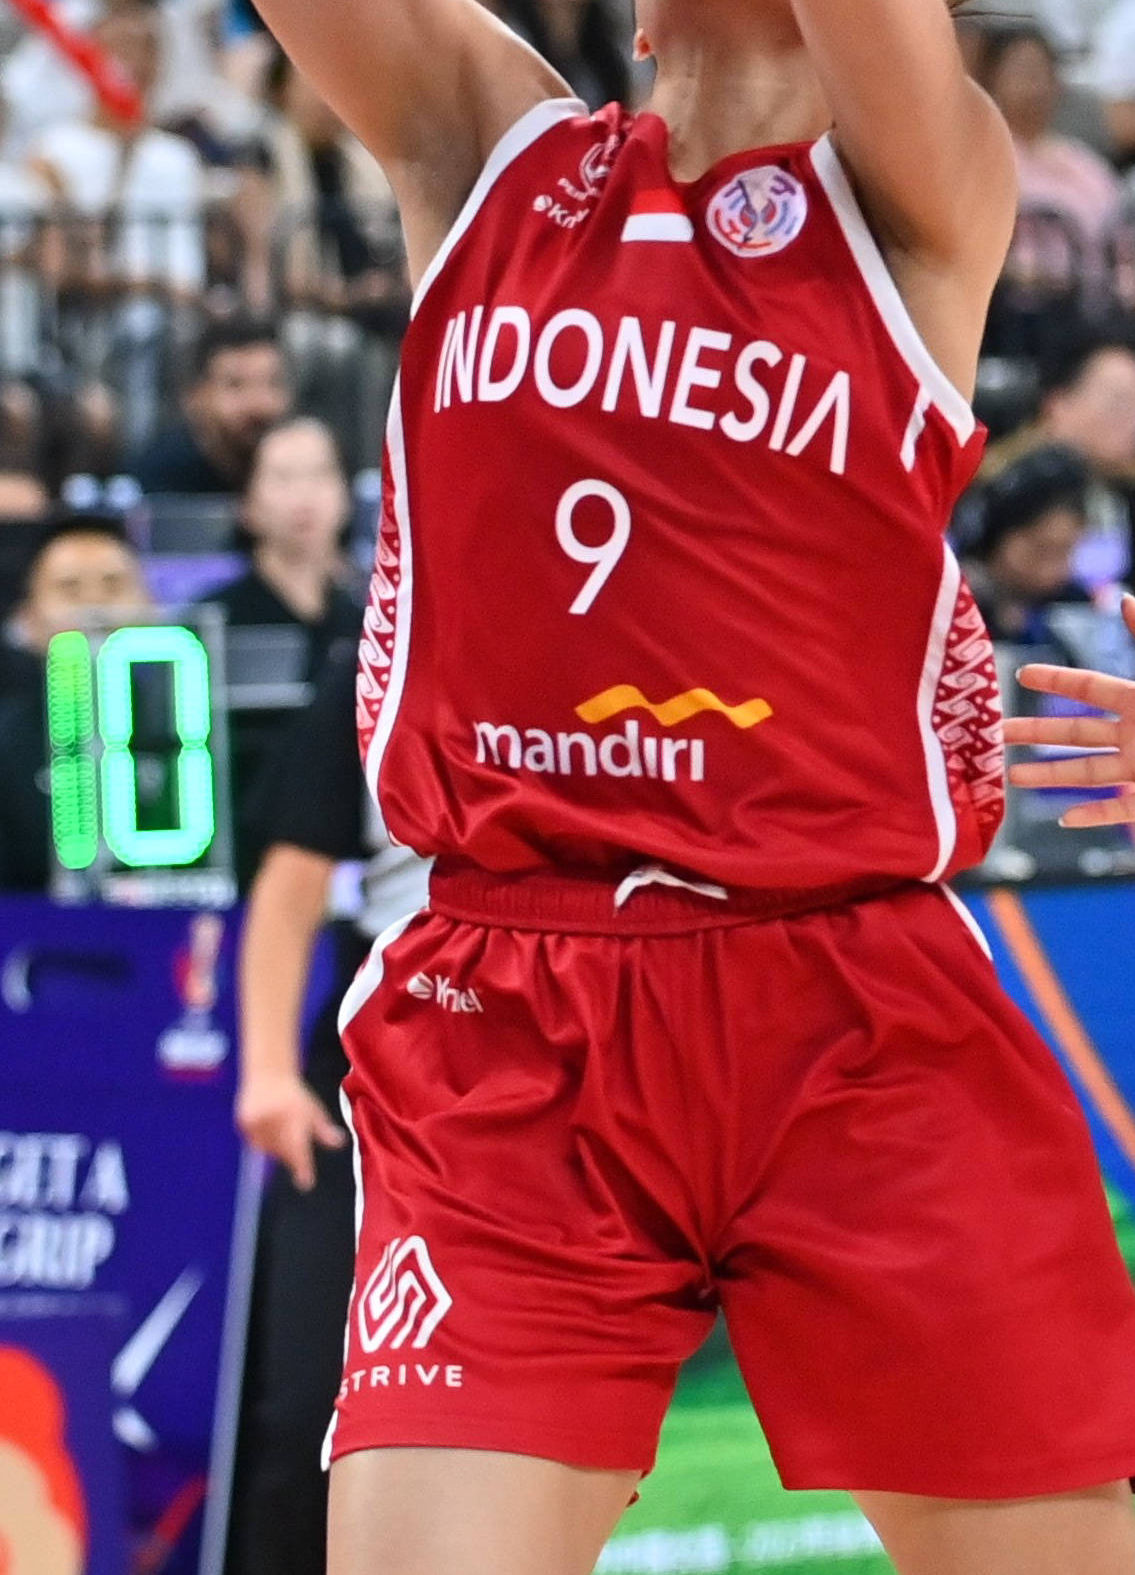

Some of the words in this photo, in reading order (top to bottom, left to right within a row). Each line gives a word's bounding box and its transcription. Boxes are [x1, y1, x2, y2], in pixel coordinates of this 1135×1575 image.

[434, 304, 850, 476] INDONESIA
[555, 478, 632, 616] 9
[473, 720, 705, 782] mandiri
